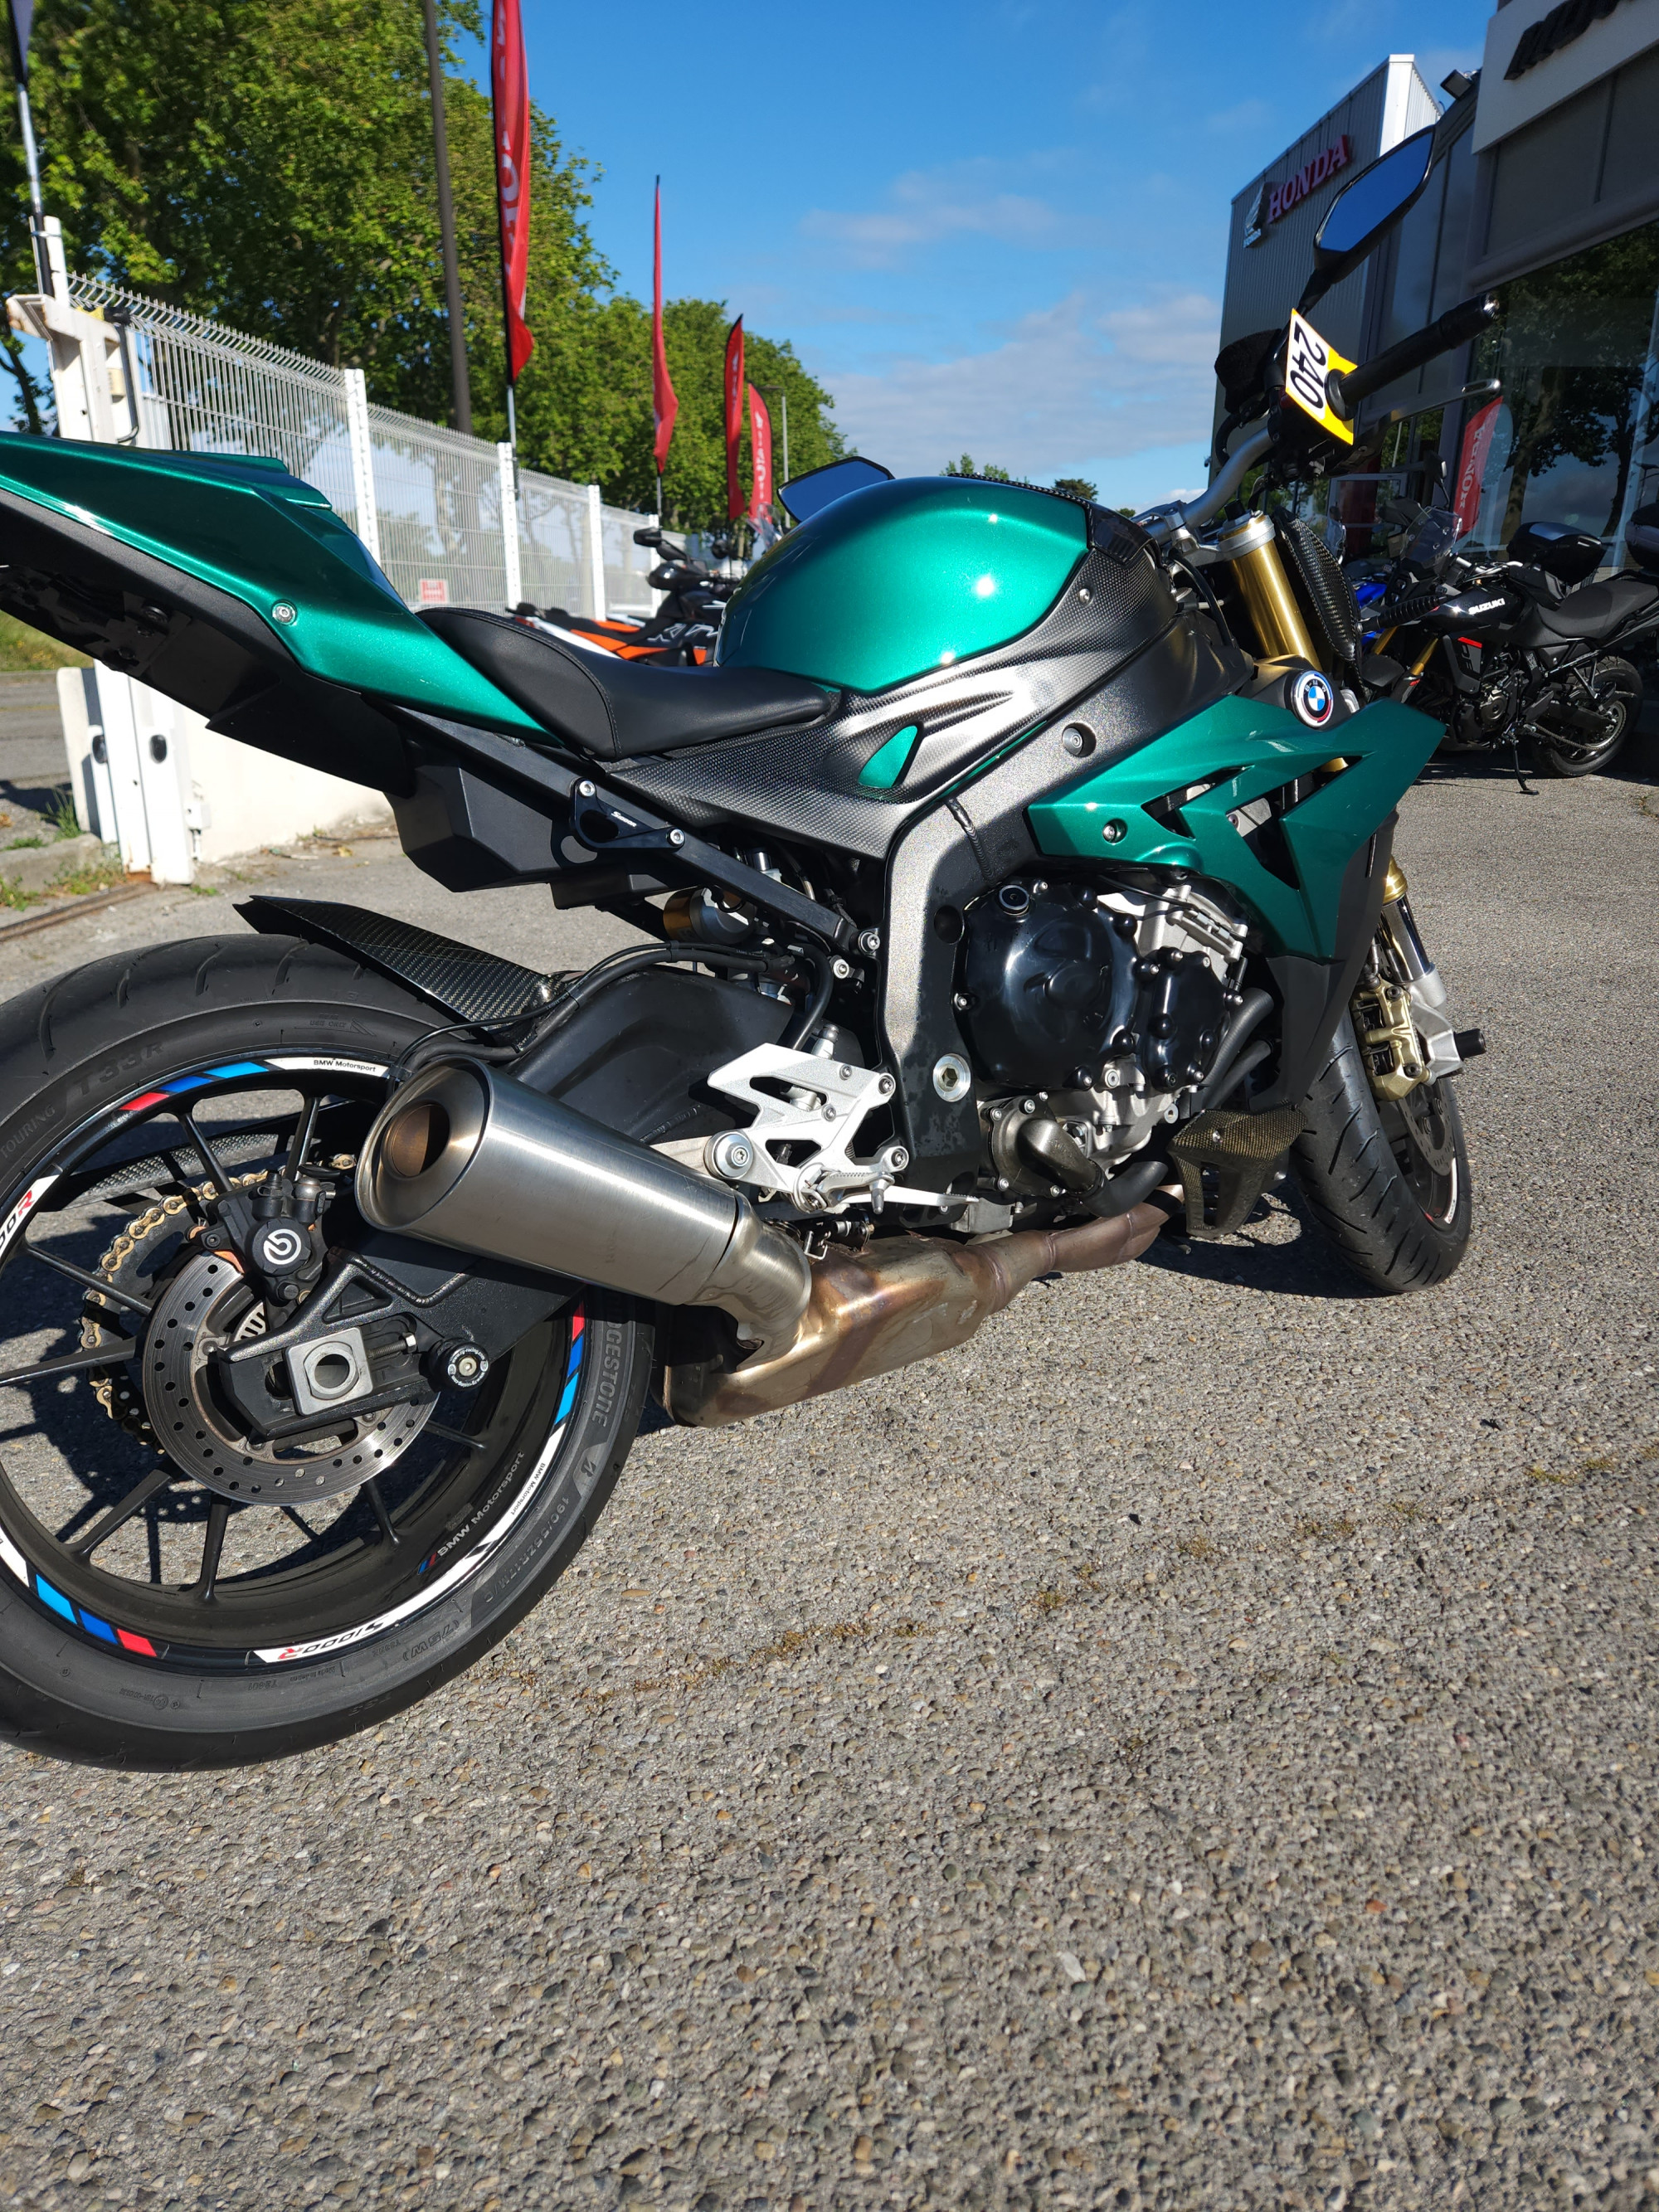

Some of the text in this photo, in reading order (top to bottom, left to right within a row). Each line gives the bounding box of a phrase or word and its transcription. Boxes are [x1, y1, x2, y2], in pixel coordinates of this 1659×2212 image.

[1267, 134, 1349, 224] HONDA
[1290, 320, 1326, 409] 240
[1468, 597, 1506, 615] SUZUKI
[335, 1061, 377, 1072] Motorsport
[0, 1105, 56, 1158] TOURING
[591, 1319, 624, 1427] DGESTONE
[436, 1524, 470, 1557] BMW
[470, 1451, 525, 1524] Motorsport
[510, 1462, 546, 1515] BMW Motorsport
[277, 1618, 386, 1660] S1000R
